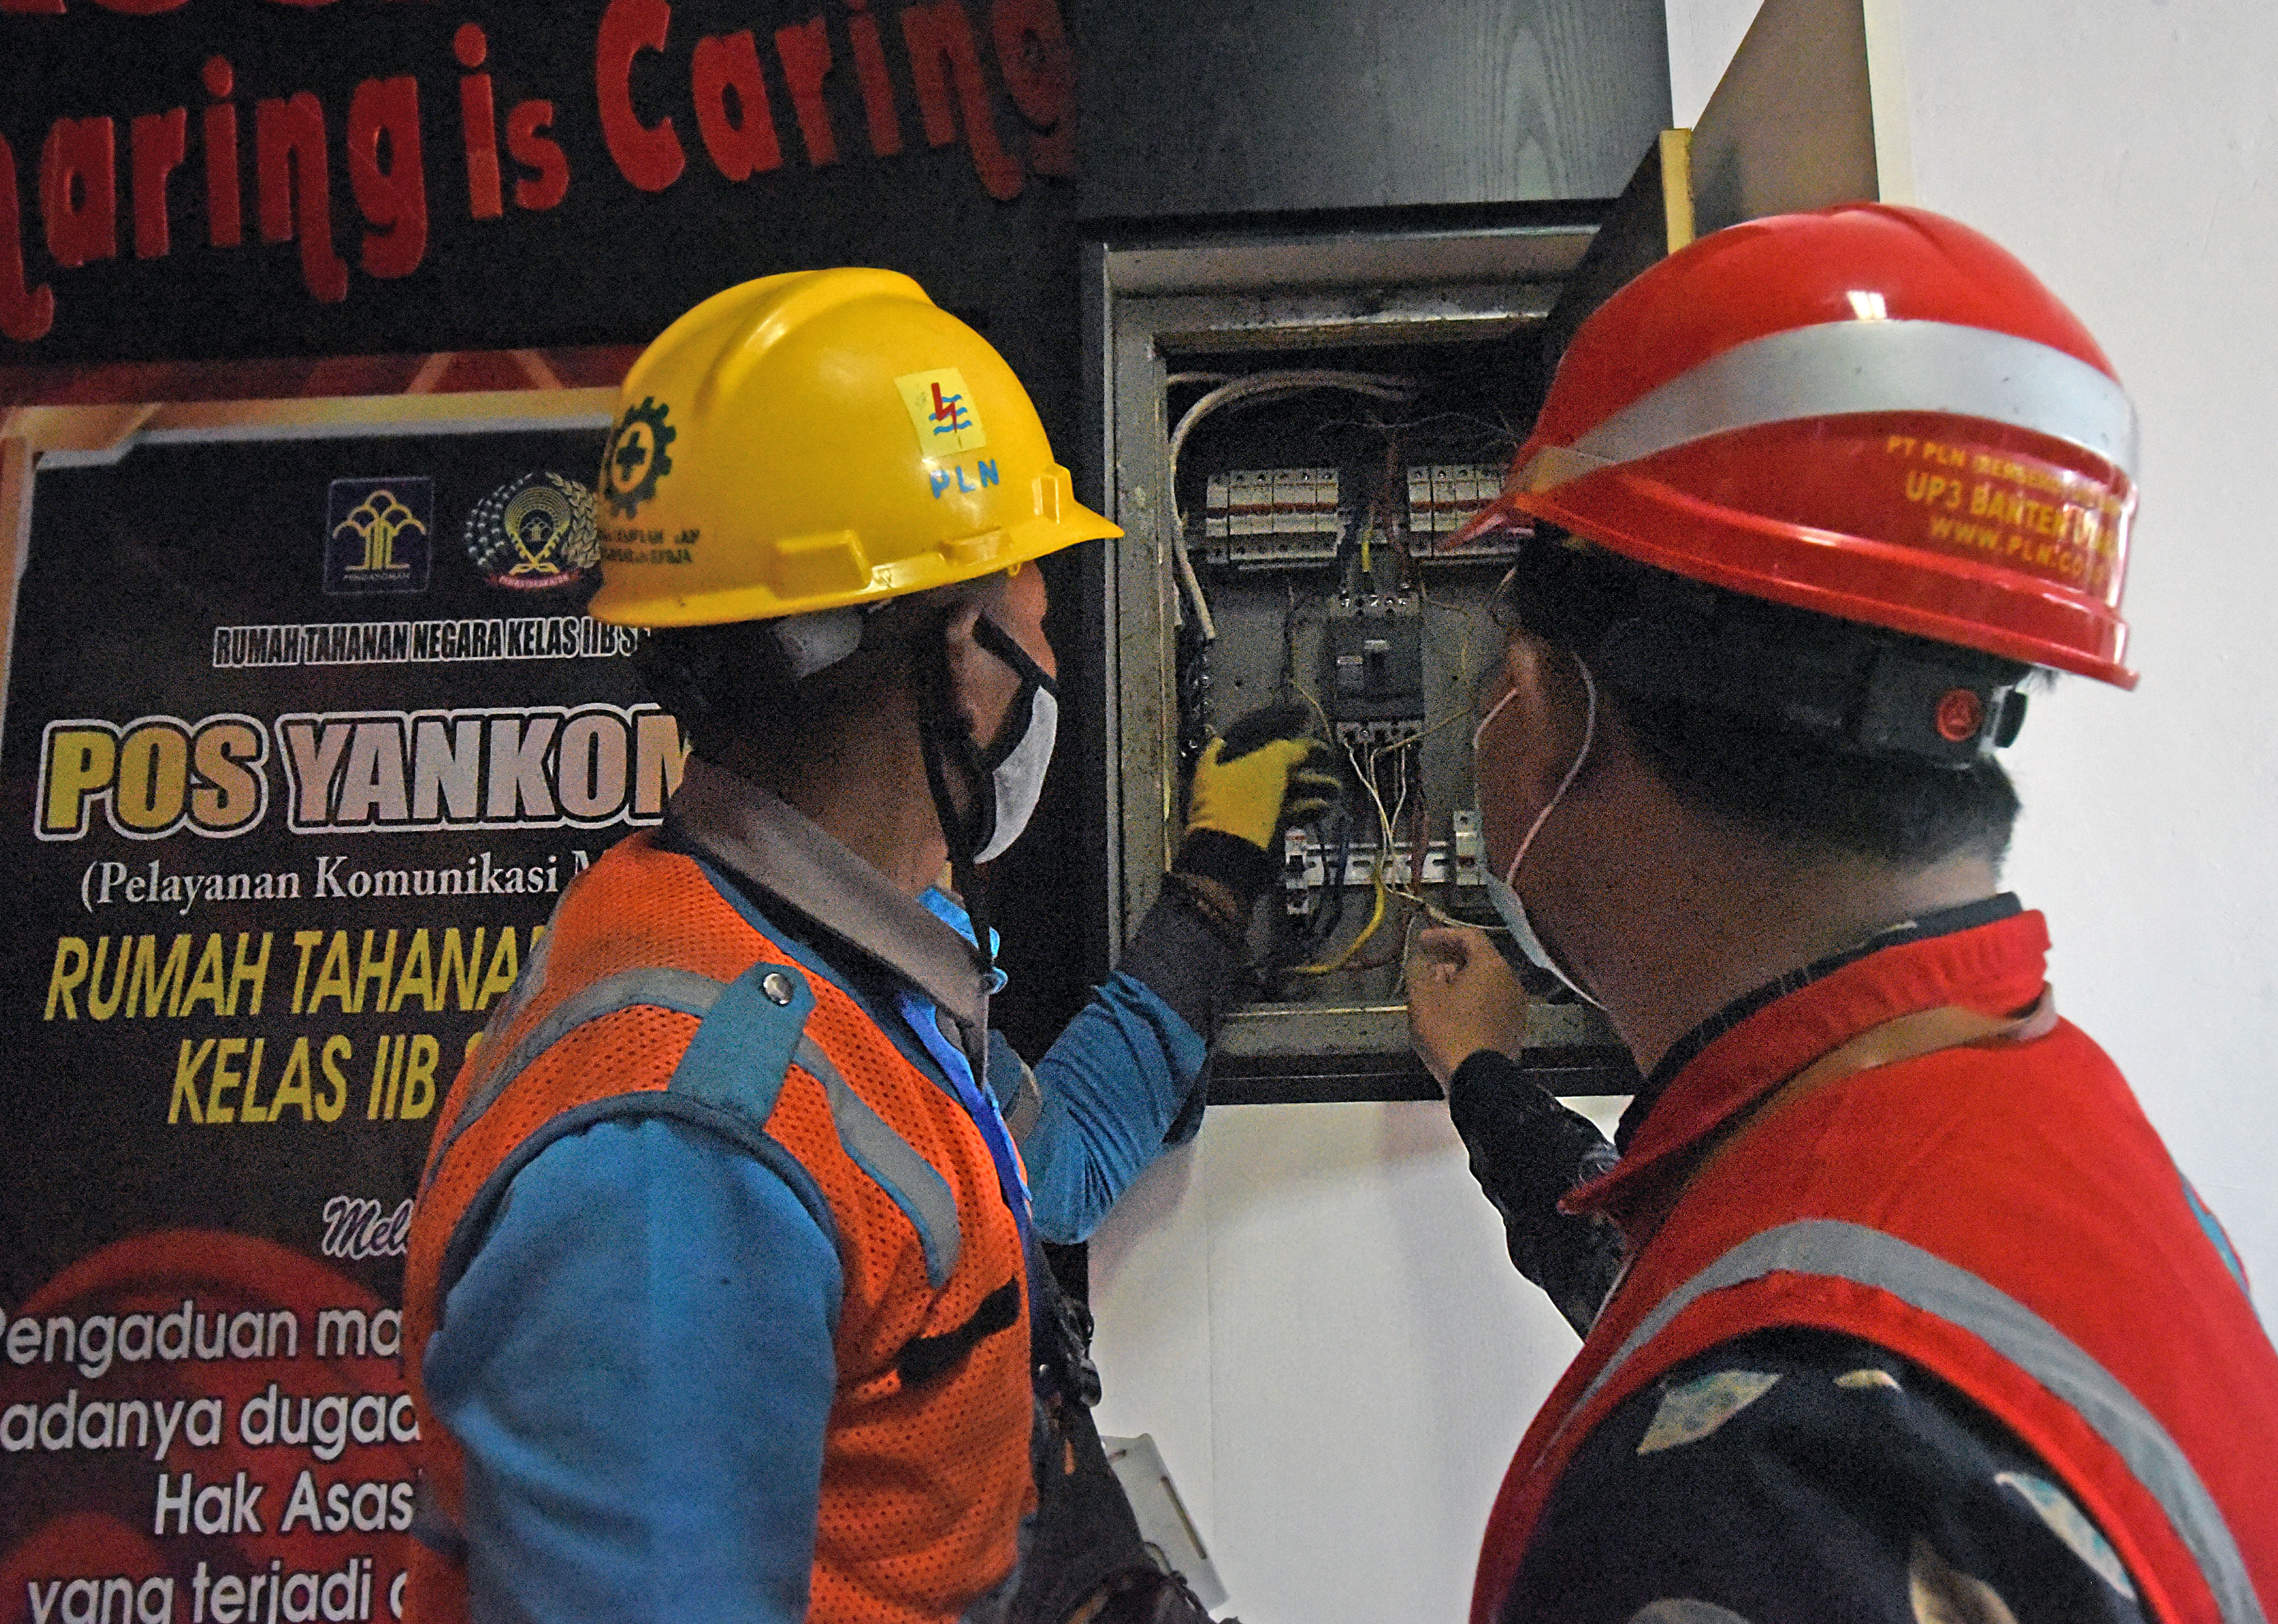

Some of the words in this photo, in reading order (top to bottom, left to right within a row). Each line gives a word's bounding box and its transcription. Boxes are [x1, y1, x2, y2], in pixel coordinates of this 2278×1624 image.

[453, 23, 570, 219] is
[595, 0, 1079, 201] Caring
[930, 458, 999, 499] PLN
[1922, 442, 1966, 468] PLN
[1905, 471, 1962, 510] UP3
[214, 625, 300, 668] RUMAH
[301, 622, 411, 665] TAHANAN
[411, 620, 505, 662] NEGARA
[505, 616, 580, 658] KELAS
[580, 616, 618, 657] IIB
[34, 713, 269, 841] POS
[80, 859, 300, 916] (Pelayanan
[313, 851, 558, 898] Komunikasi
[44, 932, 273, 1021] RUMAH
[292, 925, 548, 1014] TAHANA
[167, 1035, 352, 1124] KELAS
[367, 1035, 440, 1121] IIB
[1, 1389, 222, 1461] adanya
[154, 1471, 264, 1535] Hak
[28, 1576, 174, 1624] yang
[192, 1559, 372, 1624] terjadi
